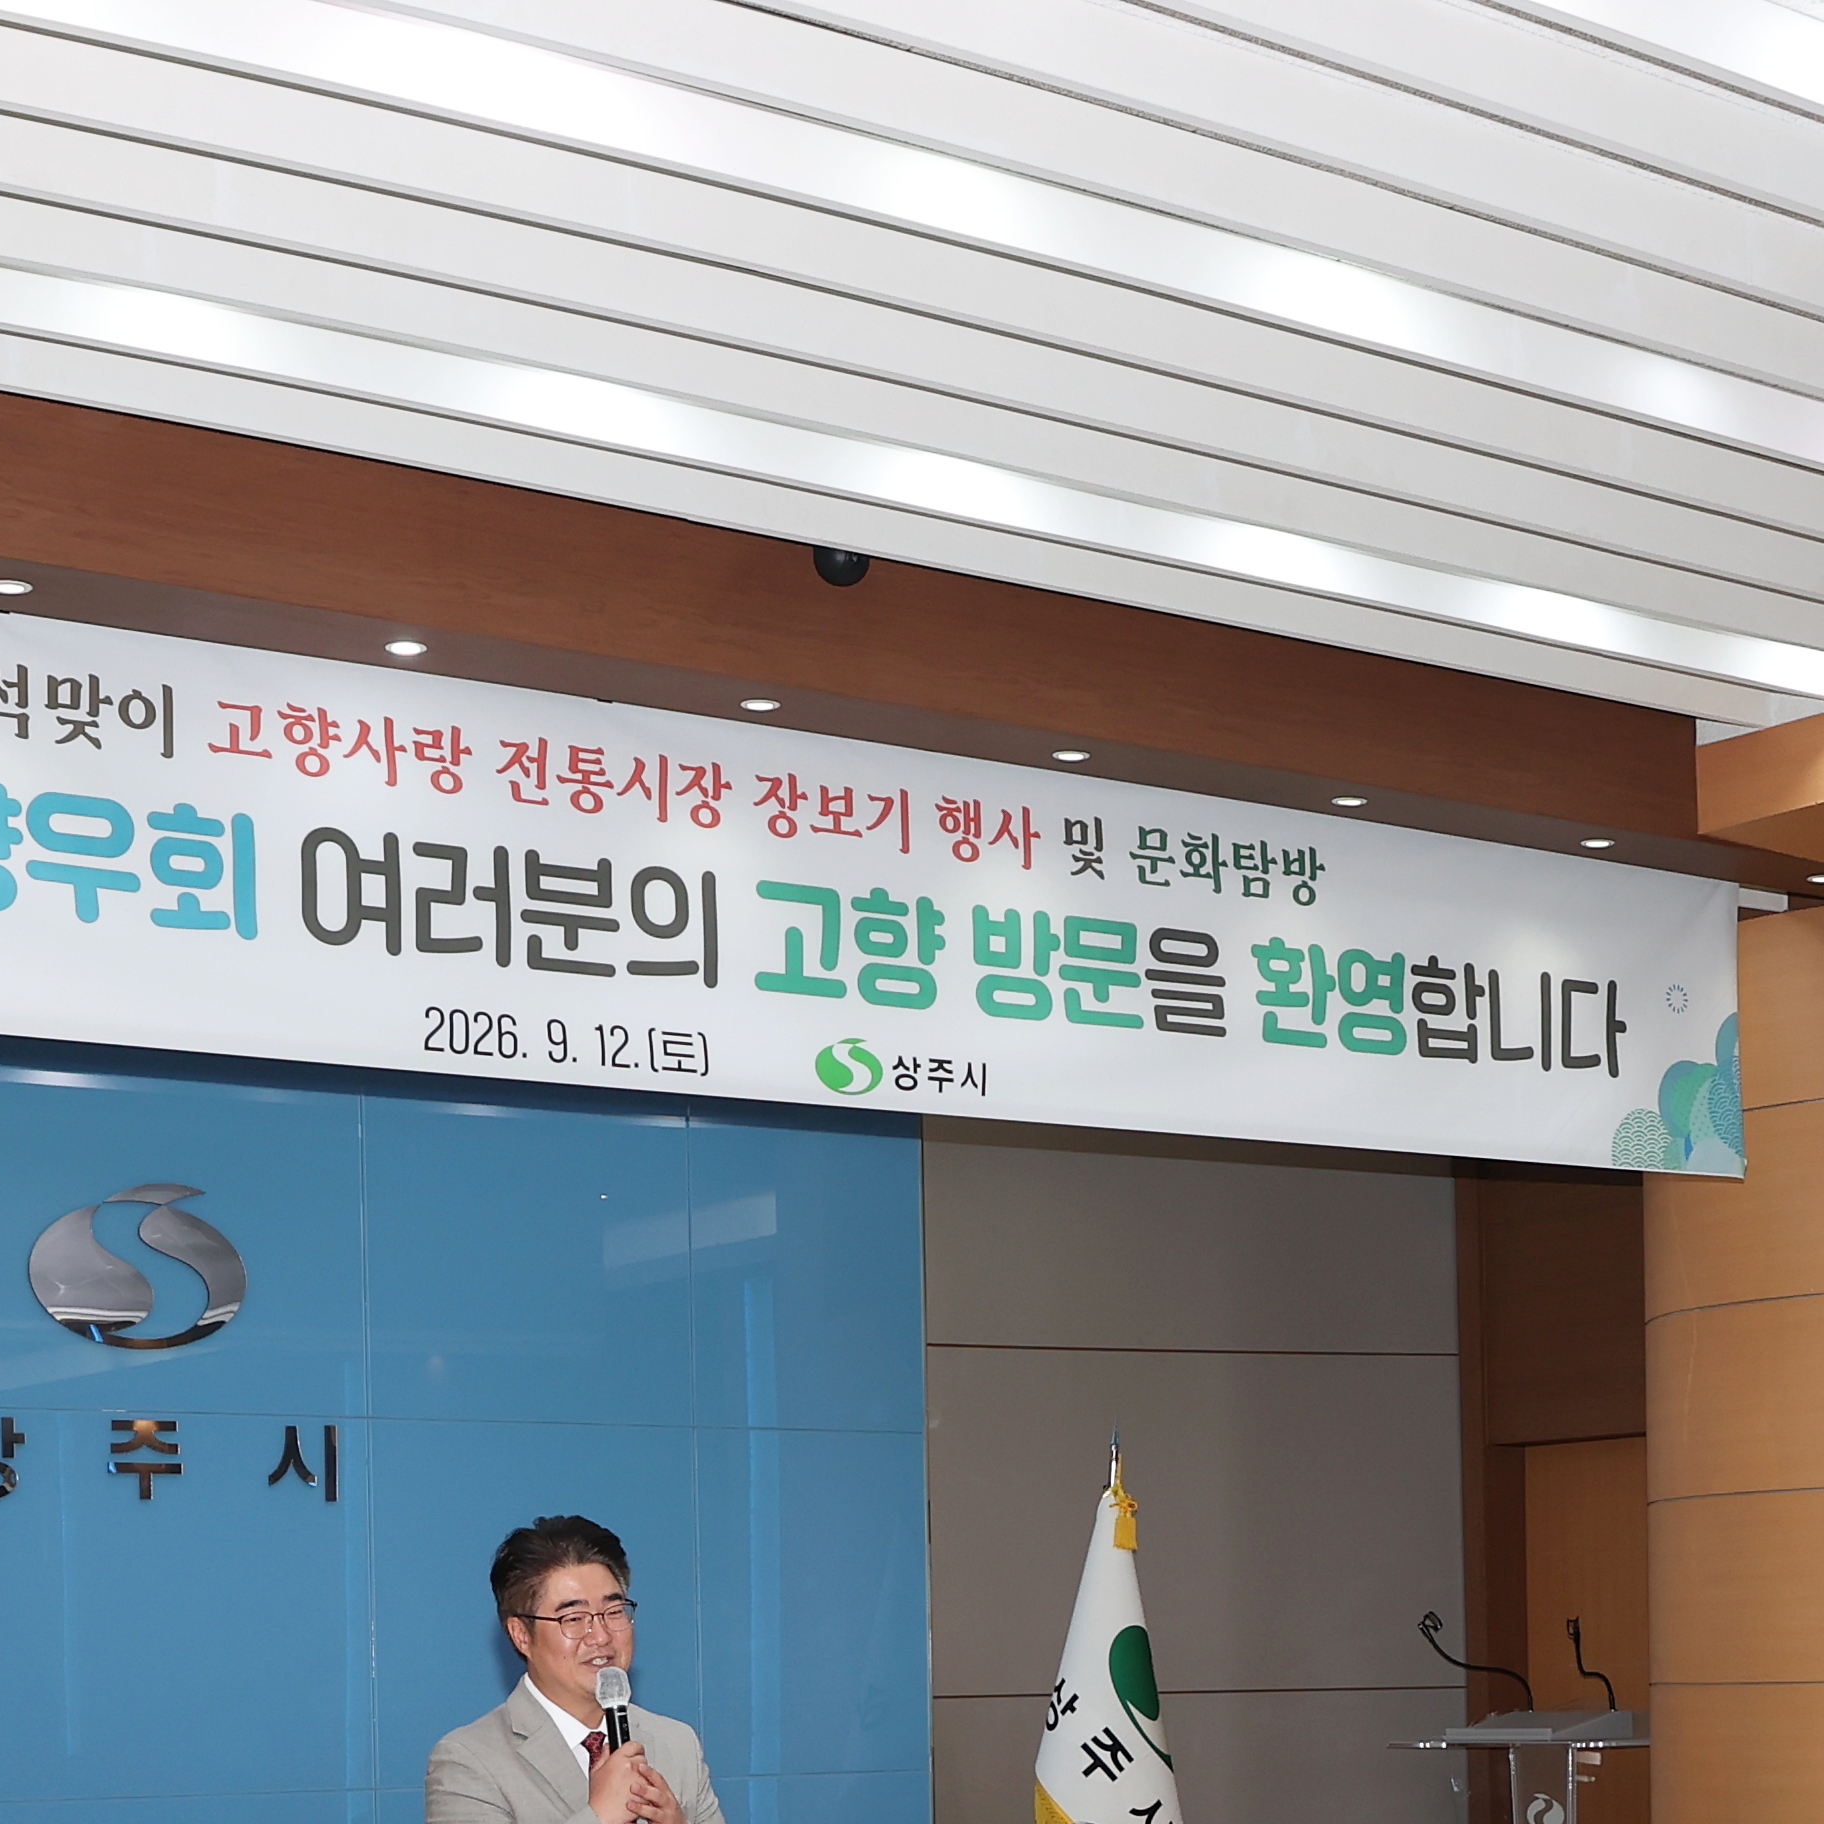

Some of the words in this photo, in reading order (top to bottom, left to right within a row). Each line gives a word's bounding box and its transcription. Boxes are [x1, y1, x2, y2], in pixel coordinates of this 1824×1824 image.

[207, 699, 473, 795] 고향사랑
[495, 736, 733, 829] 전통시장
[752, 771, 911, 855] 장보기
[934, 792, 1042, 871] 행사
[1062, 814, 1105, 881] 및
[1128, 824, 1326, 907] 문화탐방
[301, 827, 718, 990] 여러분의
[753, 878, 947, 1010] 고향
[974, 904, 1228, 1038] 방문을
[1250, 935, 1628, 1079] 환영합니다
[424, 1006, 528, 1060] 2026.
[546, 1018, 578, 1064] 9.
[891, 1055, 988, 1097] 상주시
